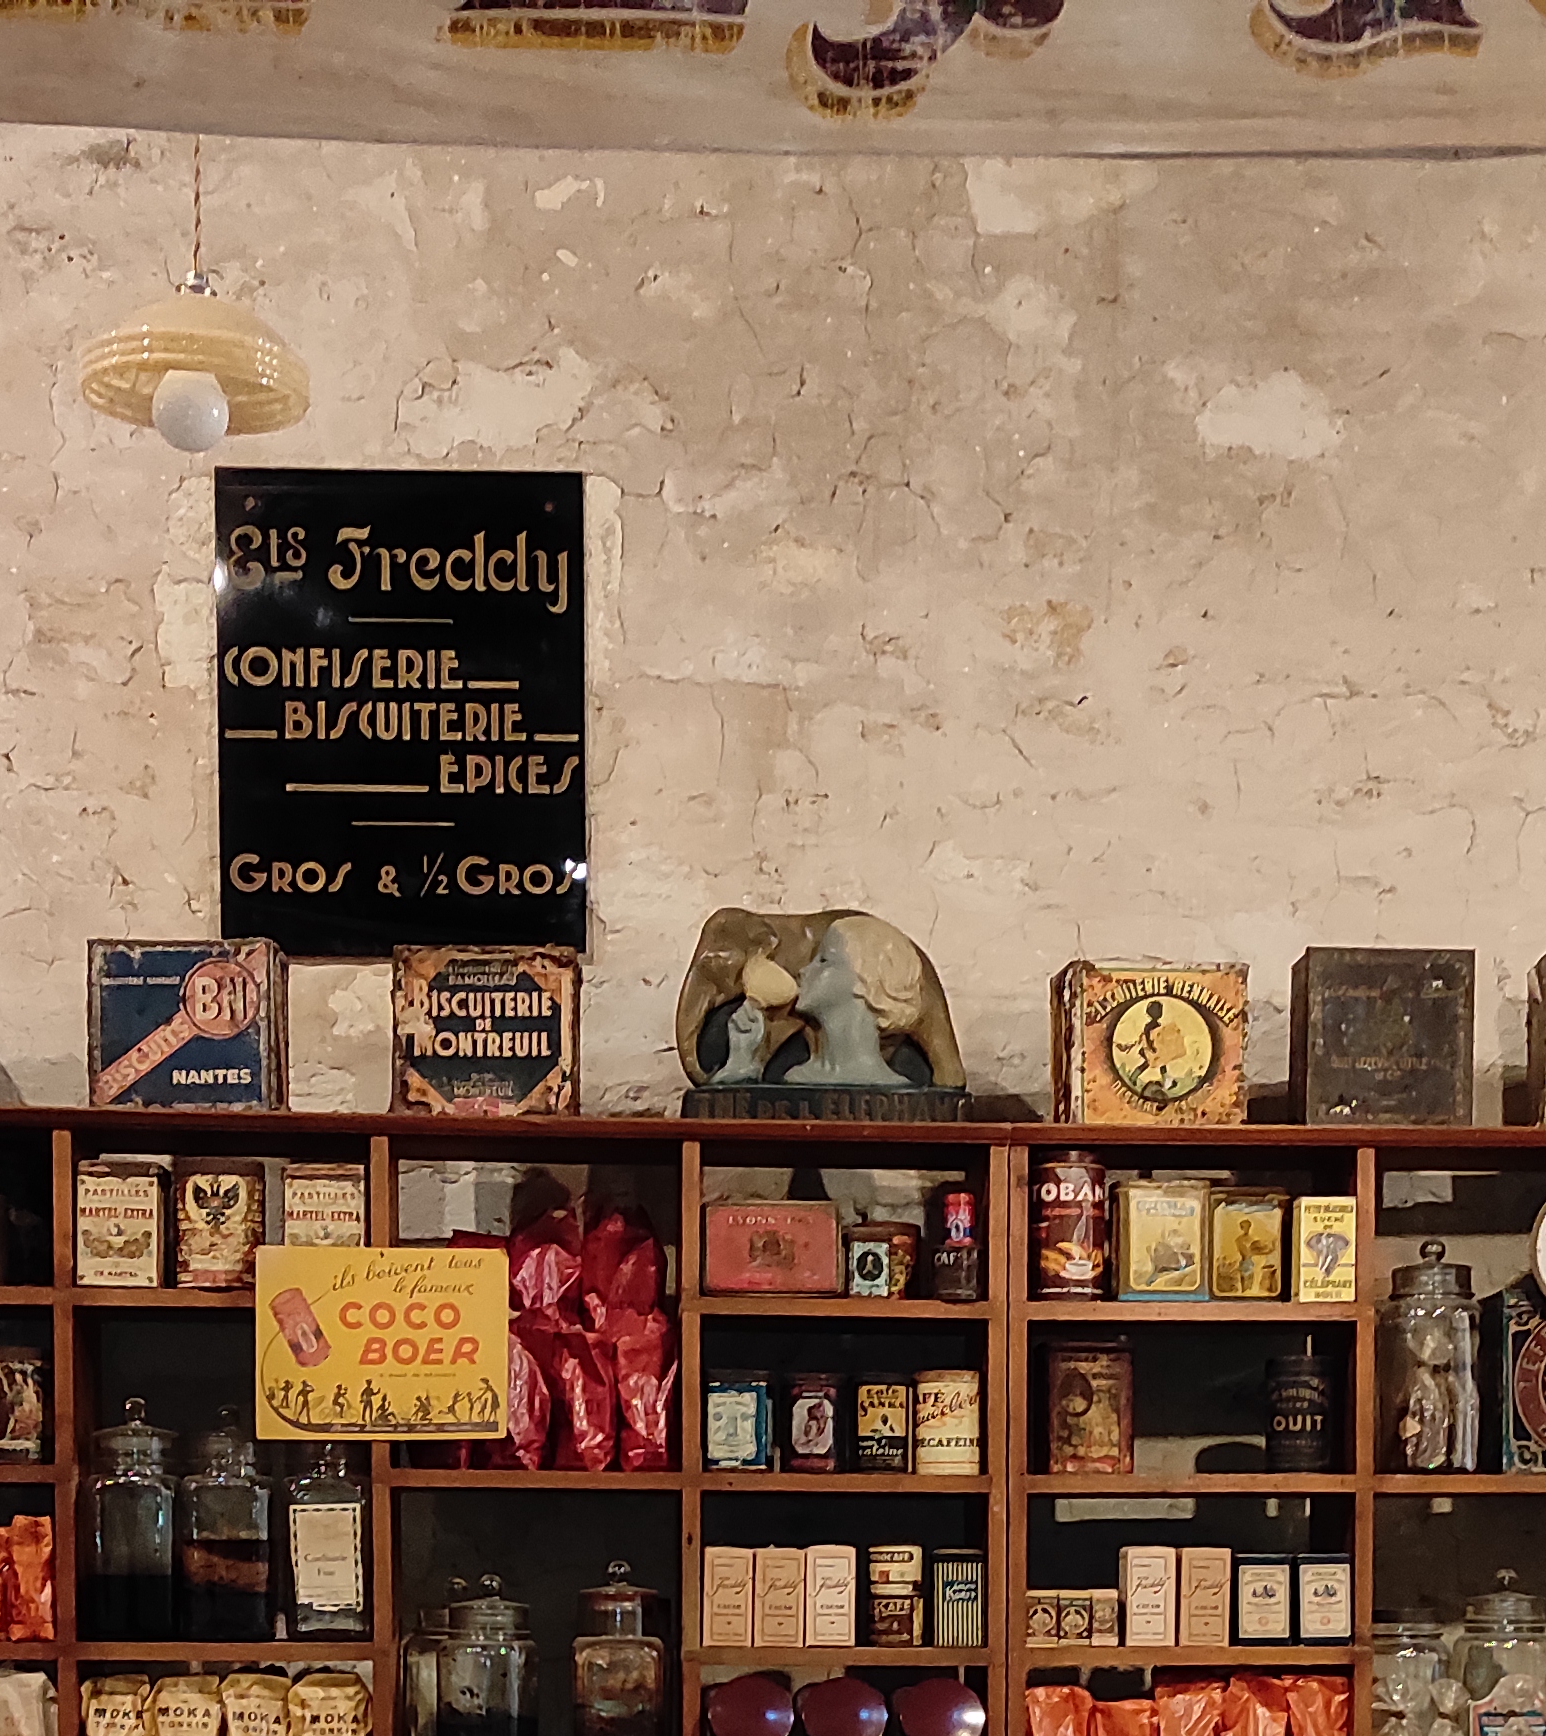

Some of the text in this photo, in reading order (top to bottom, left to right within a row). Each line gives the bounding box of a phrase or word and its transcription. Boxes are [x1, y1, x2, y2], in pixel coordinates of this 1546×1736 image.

[327, 524, 569, 614] Freddy
[224, 646, 463, 690] CONFISERIE
[284, 700, 527, 742] BISCUITERIE
[229, 853, 352, 895] GROS
[377, 864, 402, 898] &
[194, 975, 248, 1022] BN
[413, 977, 553, 1018] BISCUITERIE
[1172, 979, 1237, 1027] RENNAISE
[475, 1017, 493, 1032] DE
[97, 1013, 191, 1099] BISCUITS
[413, 1030, 553, 1058] MONTREUIL
[171, 1067, 253, 1087] NANTES
[83, 1188, 150, 1199] PASTILLES
[122, 1208, 155, 1221] EXTRA
[445, 1254, 485, 1270] tous
[338, 1300, 461, 1331] COCO
[358, 1335, 480, 1366] BOER
[93, 1707, 144, 1721] MOKA
[157, 1706, 212, 1720] MOKA
[231, 1710, 282, 1727] MOKA
[309, 1712, 361, 1726] MOKA
